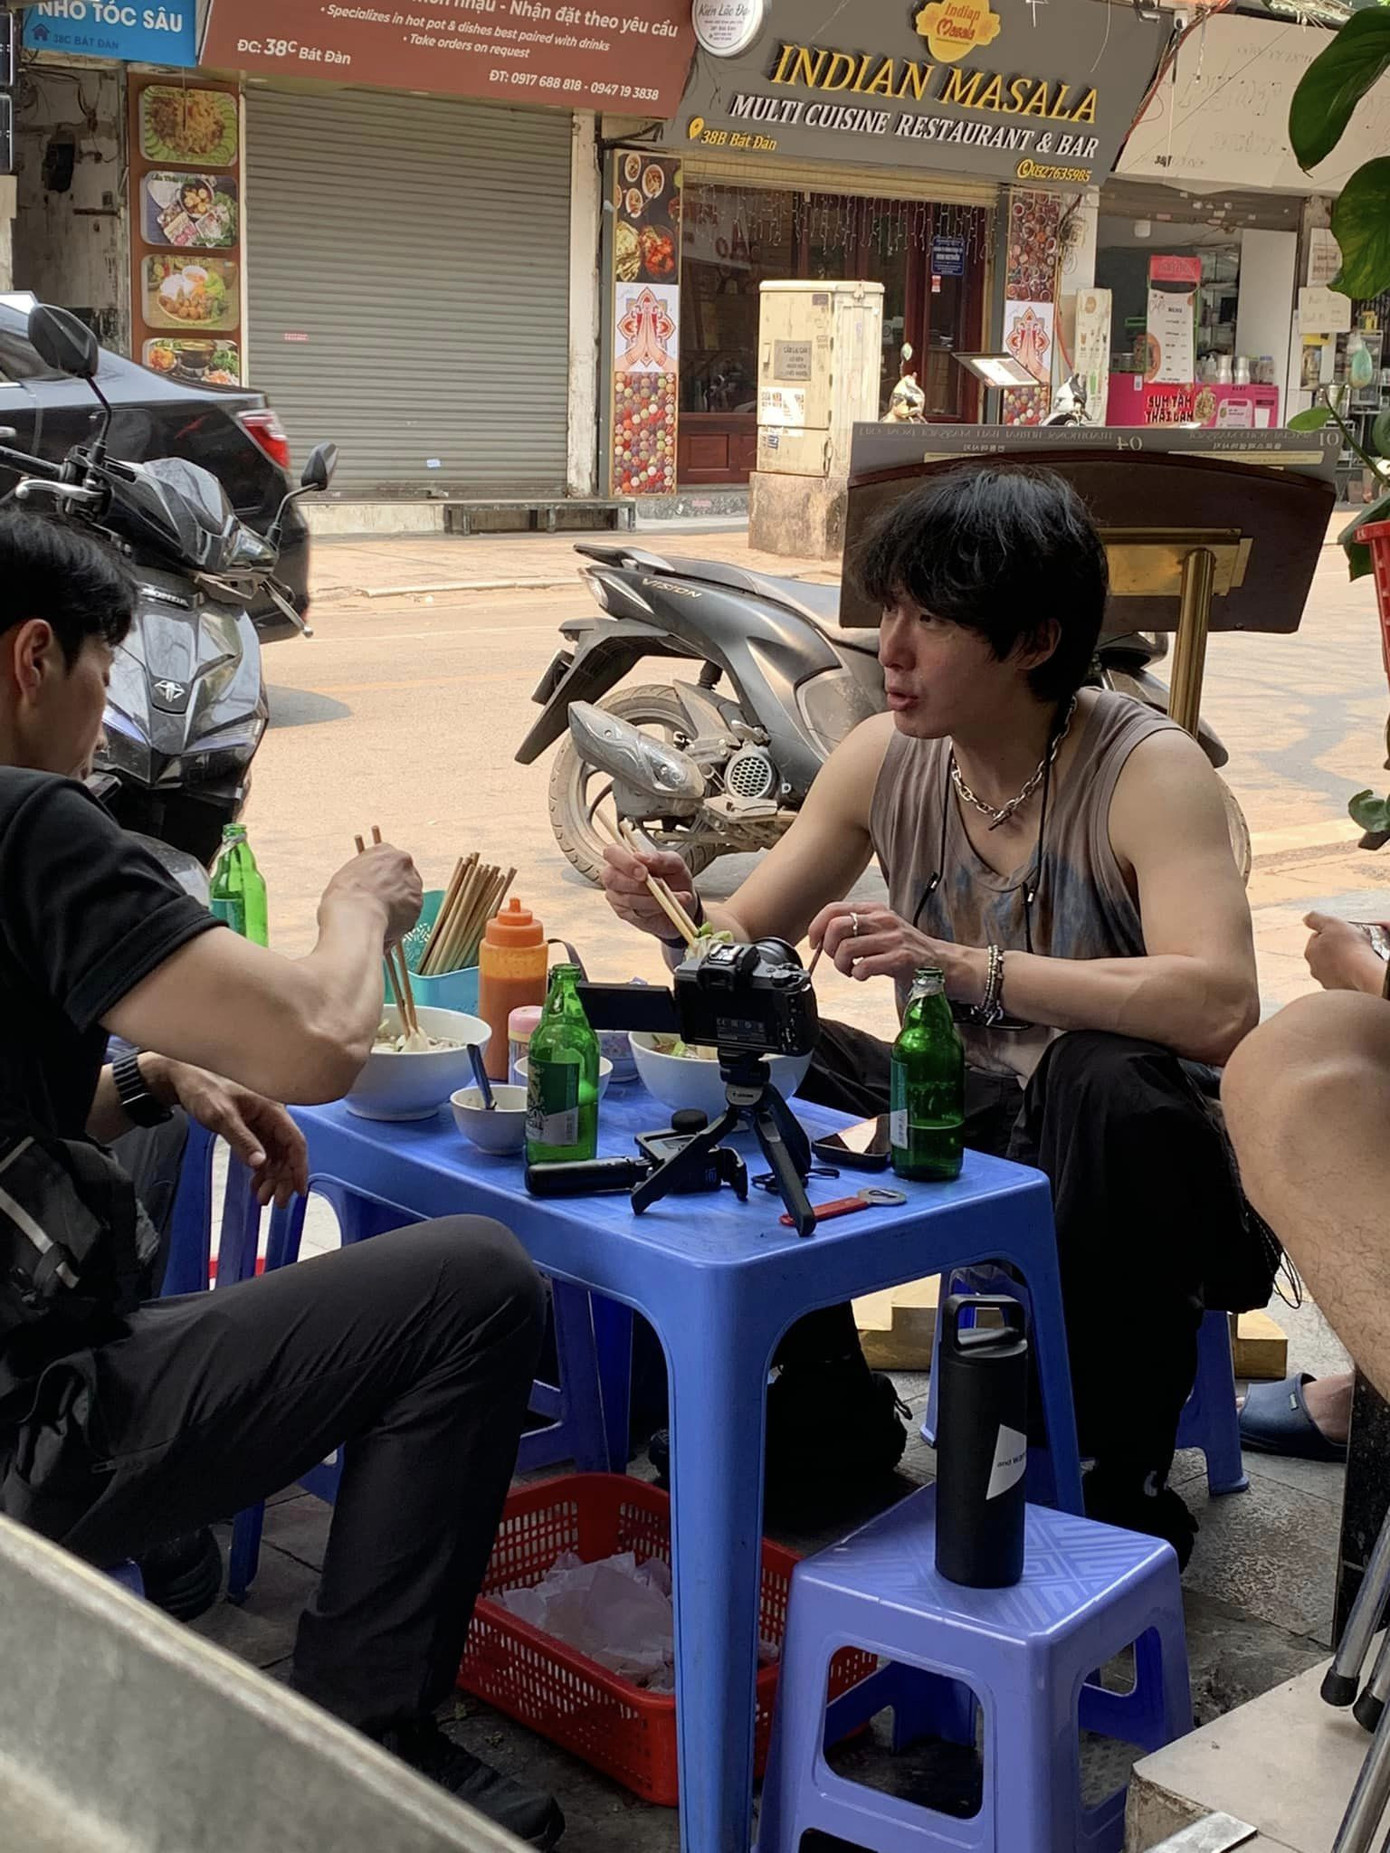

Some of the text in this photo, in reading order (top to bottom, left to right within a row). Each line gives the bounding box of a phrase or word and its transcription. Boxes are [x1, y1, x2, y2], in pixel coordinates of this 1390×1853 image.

[93, 0, 137, 26] TÓC
[143, 7, 182, 33] SÂU
[509, 0, 551, 22] Nhận
[555, 7, 580, 27] đặt
[584, 11, 619, 29] theo
[620, 16, 648, 34] yêu
[945, 3, 981, 21] Indian
[327, 4, 610, 51] Specializes in hot pot & dishes best paired with drinks
[237, 39, 262, 52] ĐC:
[299, 46, 321, 61] Bát
[324, 50, 351, 65] Đàn
[410, 33, 531, 58] Take orders on request
[489, 70, 508, 82] ĐT:
[511, 72, 538, 86] 0917
[539, 75, 561, 88] 688
[563, 77, 582, 91] 818
[590, 82, 618, 95] 0947
[619, 85, 631, 97] 19
[632, 87, 659, 100] 3838
[770, 44, 1097, 124] INDIAN MASALA
[701, 130, 727, 145] 38B
[729, 132, 751, 147] Bát
[730, 95, 1099, 159] MULTI CUISINE RESTAURANT & BAR
[642, 578, 702, 599] VISION
